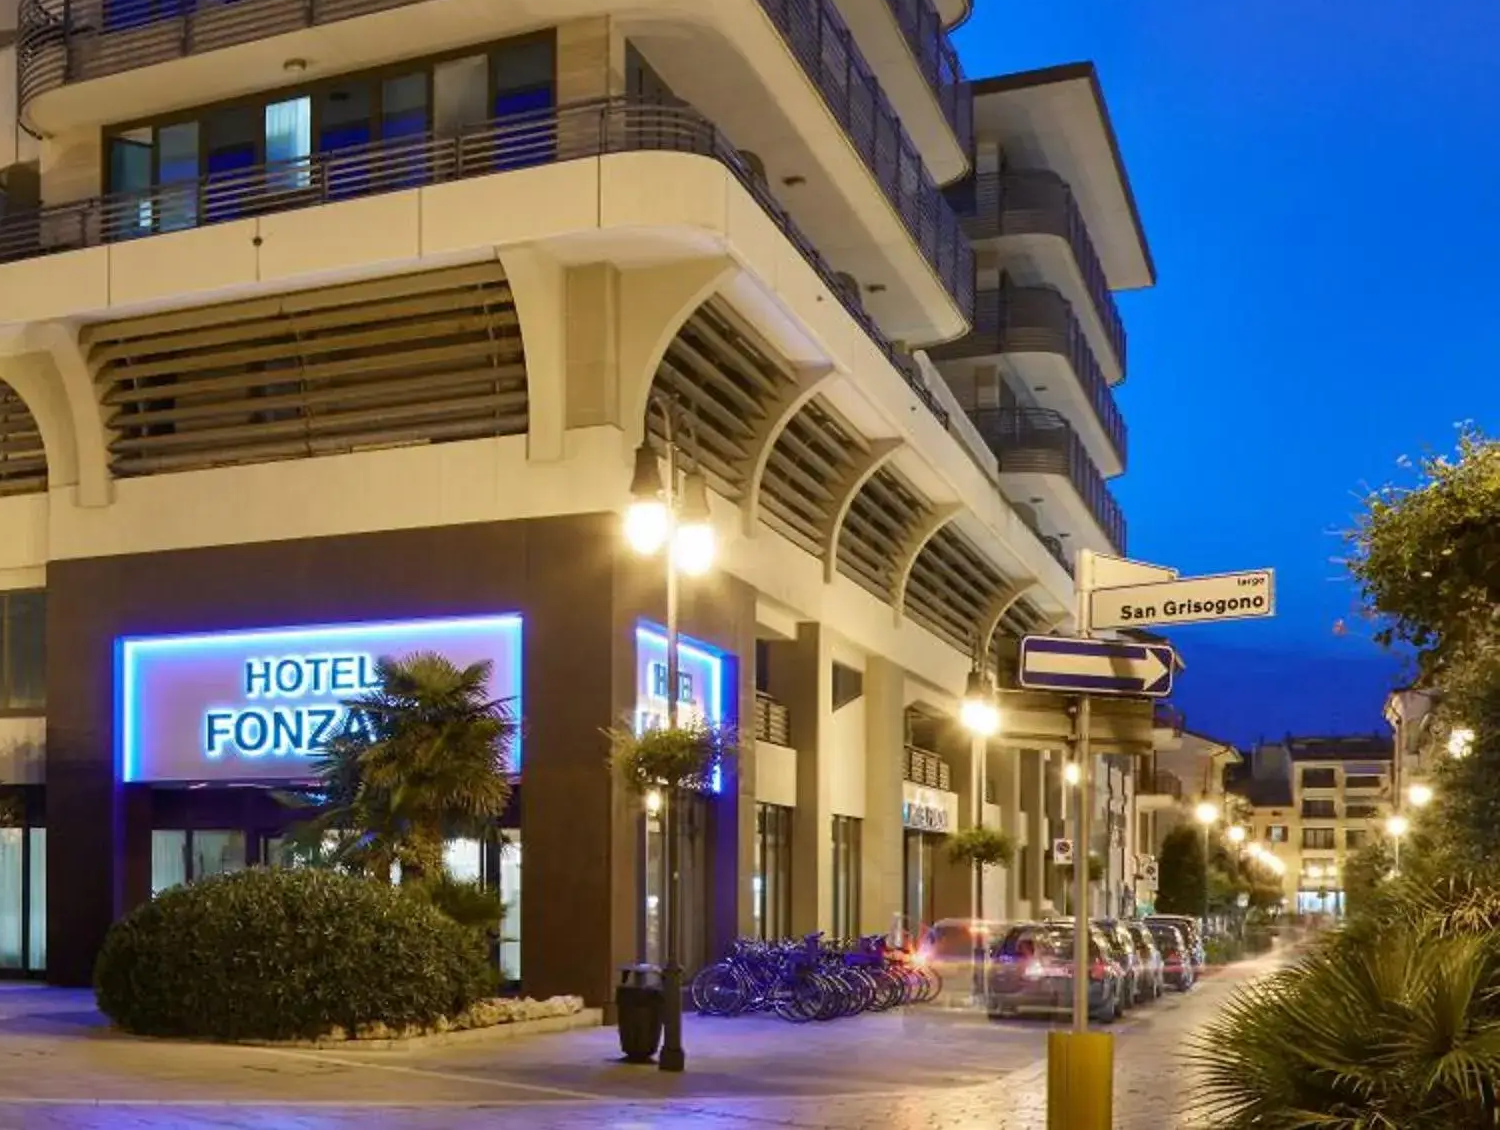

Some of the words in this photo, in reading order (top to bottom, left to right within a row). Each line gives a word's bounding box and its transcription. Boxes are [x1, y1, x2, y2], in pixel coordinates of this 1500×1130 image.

[1120, 604, 1157, 620] San
[1163, 594, 1265, 617] Grisogono
[245, 655, 382, 694] HOTEL
[206, 707, 390, 752] FONZA
